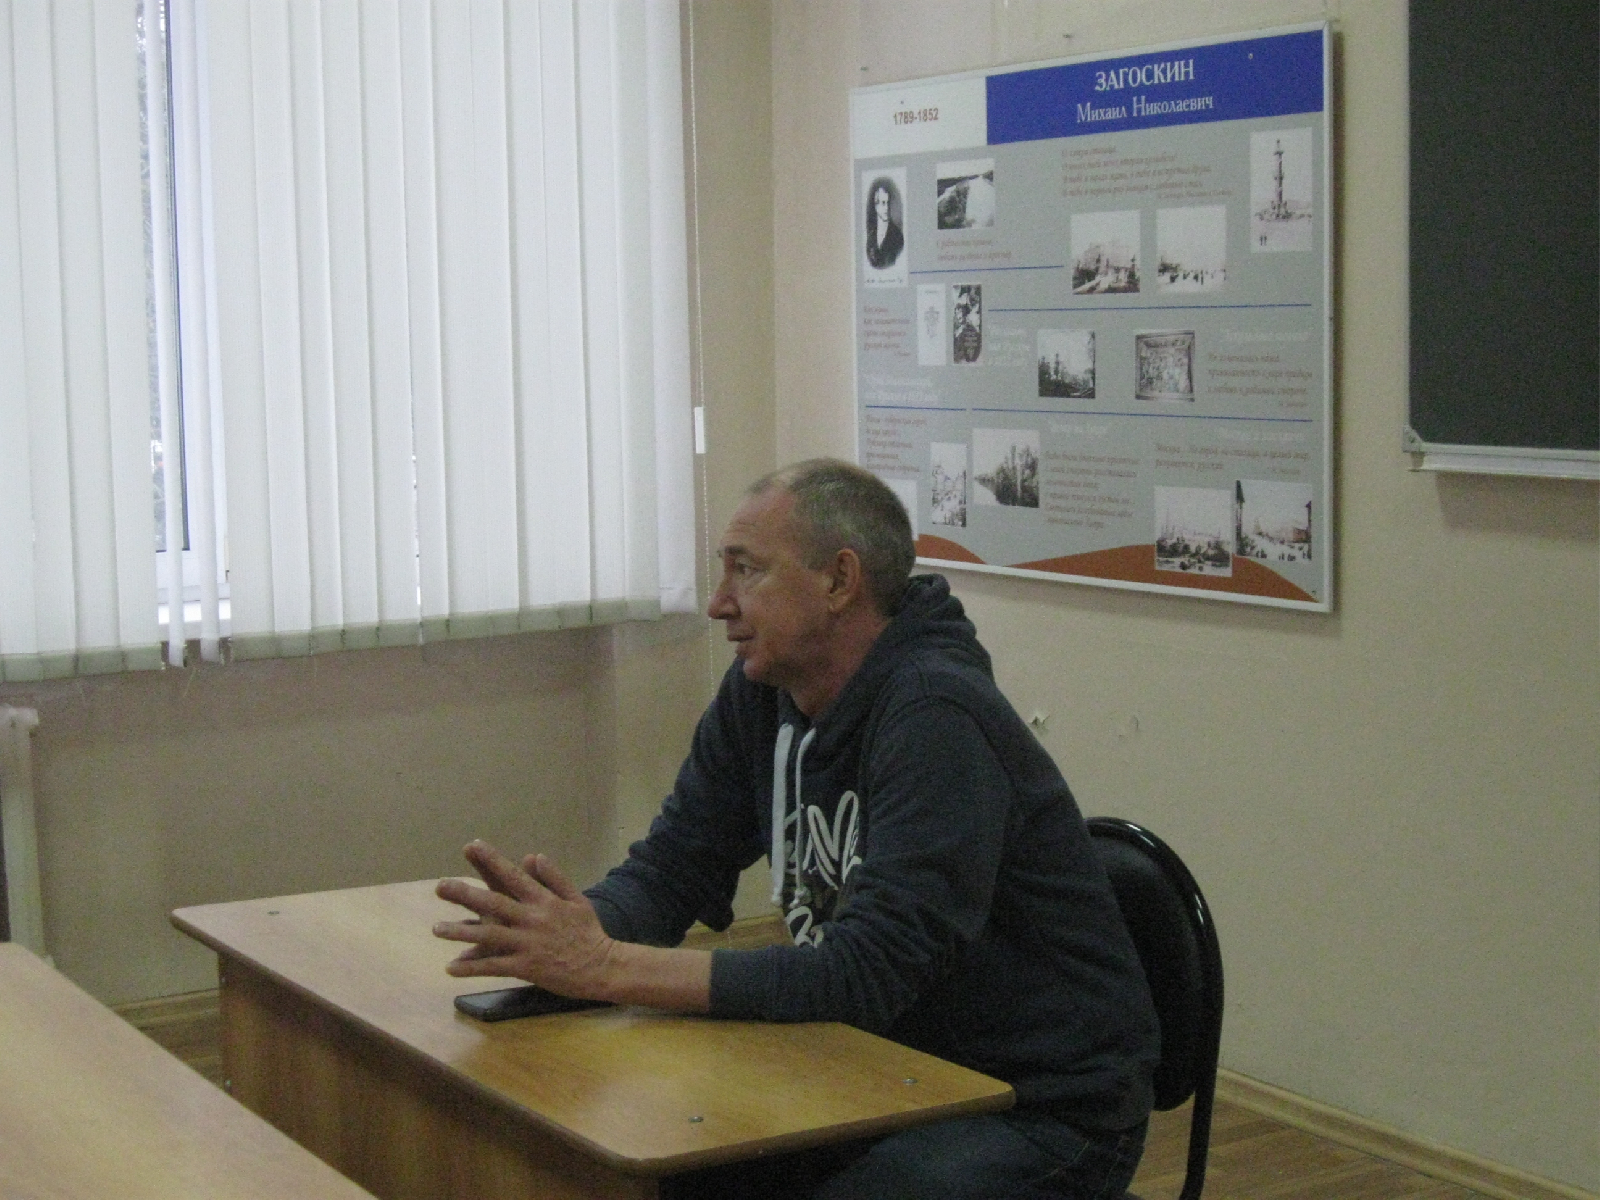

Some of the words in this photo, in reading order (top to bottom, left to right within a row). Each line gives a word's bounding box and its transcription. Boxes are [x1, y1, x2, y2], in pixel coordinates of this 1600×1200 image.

[1095, 59, 1195, 91] ЗАГОСКИН
[893, 108, 939, 125] 1789-1852
[1077, 102, 1128, 123] Михаил
[1132, 95, 1214, 117] Николаевич
